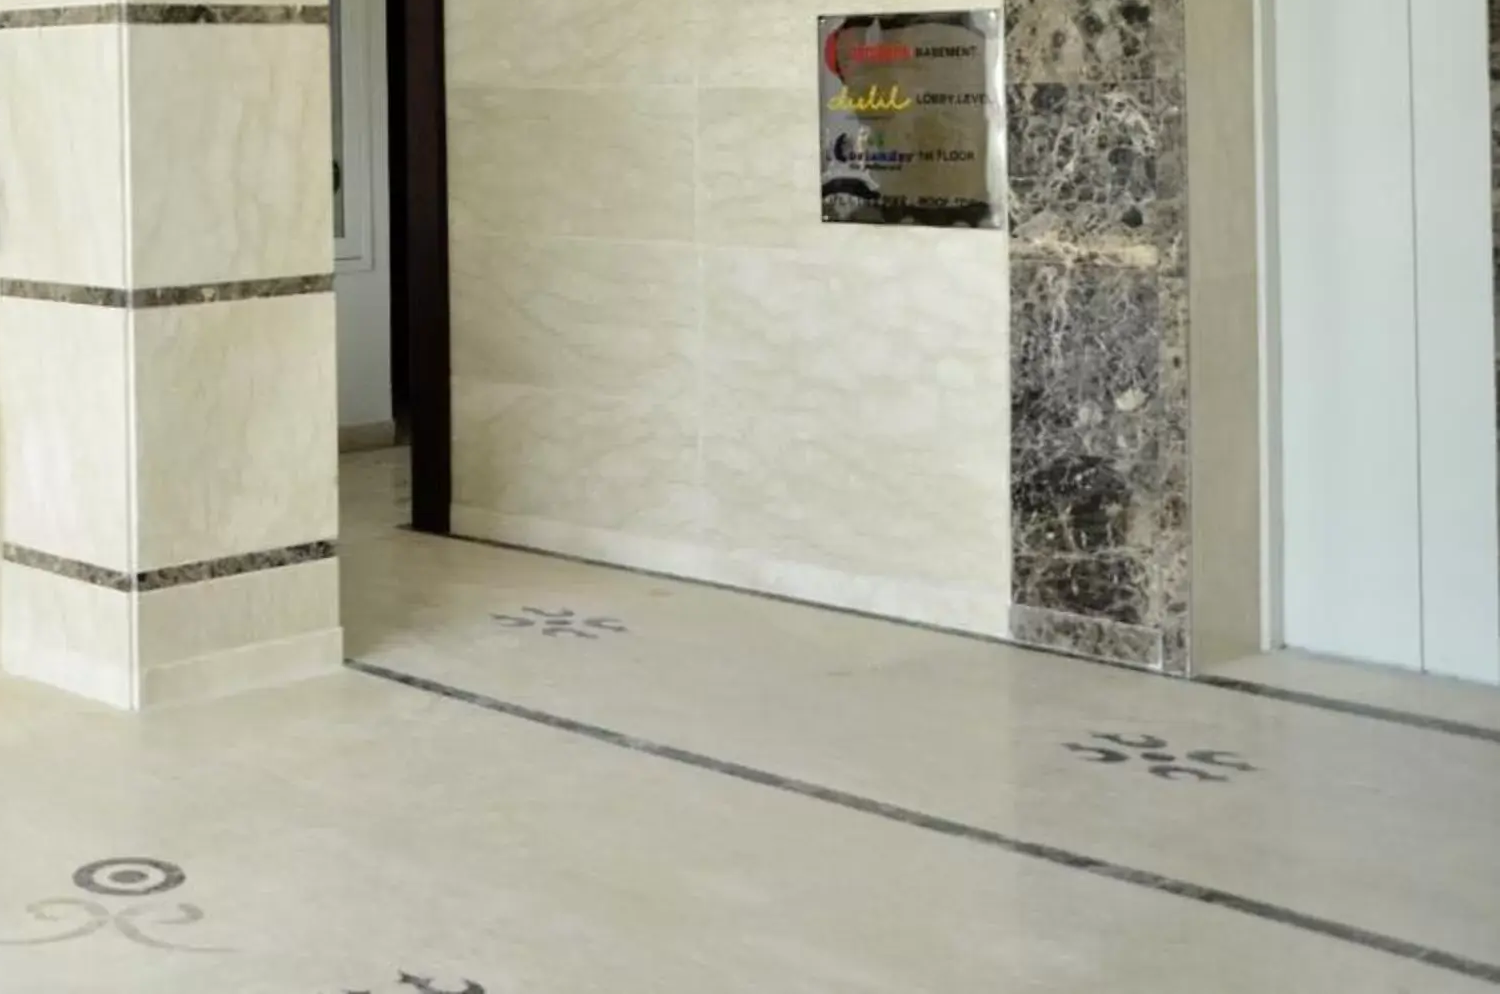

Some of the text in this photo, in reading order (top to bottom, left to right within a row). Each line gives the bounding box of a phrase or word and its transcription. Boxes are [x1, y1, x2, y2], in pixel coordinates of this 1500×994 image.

[915, 45, 977, 59] BASEMENT
[915, 92, 955, 105] LOBBY
[936, 149, 976, 162] FLOOR
